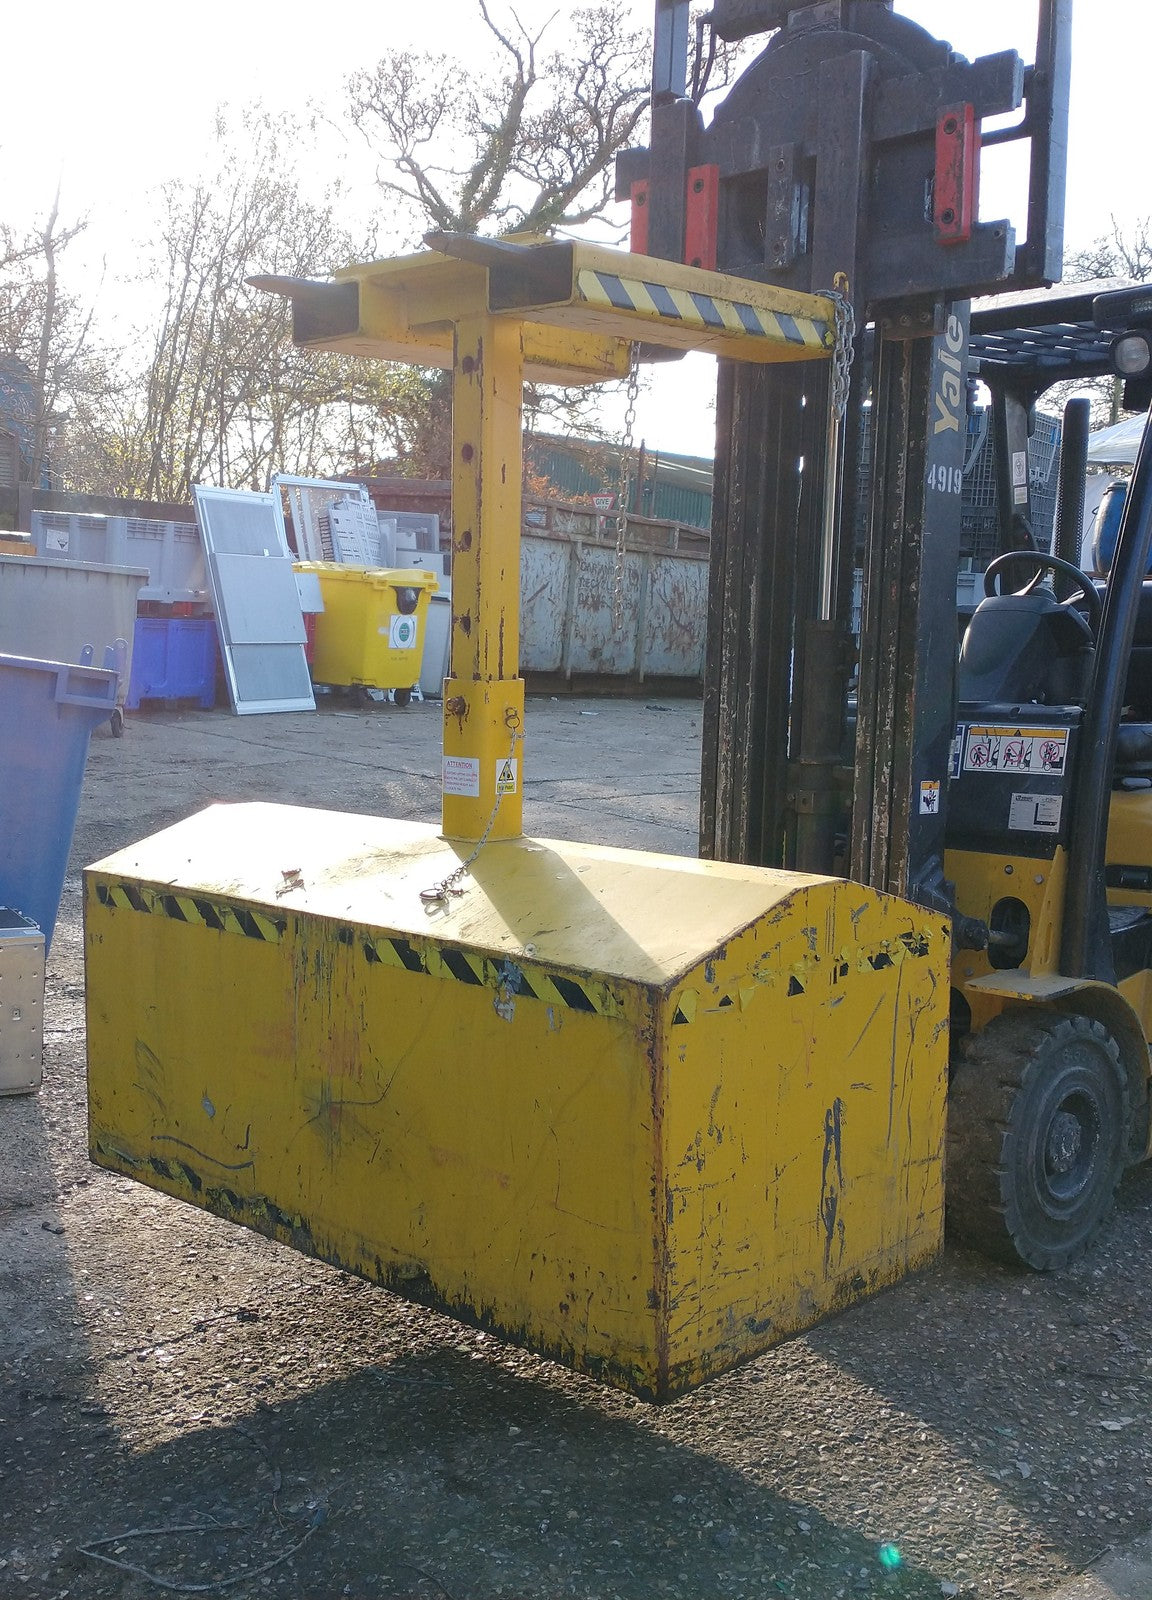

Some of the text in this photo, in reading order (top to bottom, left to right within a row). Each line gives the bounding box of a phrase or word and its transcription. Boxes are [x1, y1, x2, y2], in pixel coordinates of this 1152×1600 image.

[934, 315, 964, 435] Yale
[927, 463, 963, 495] 4919
[446, 760, 473, 769] ATTENTION
